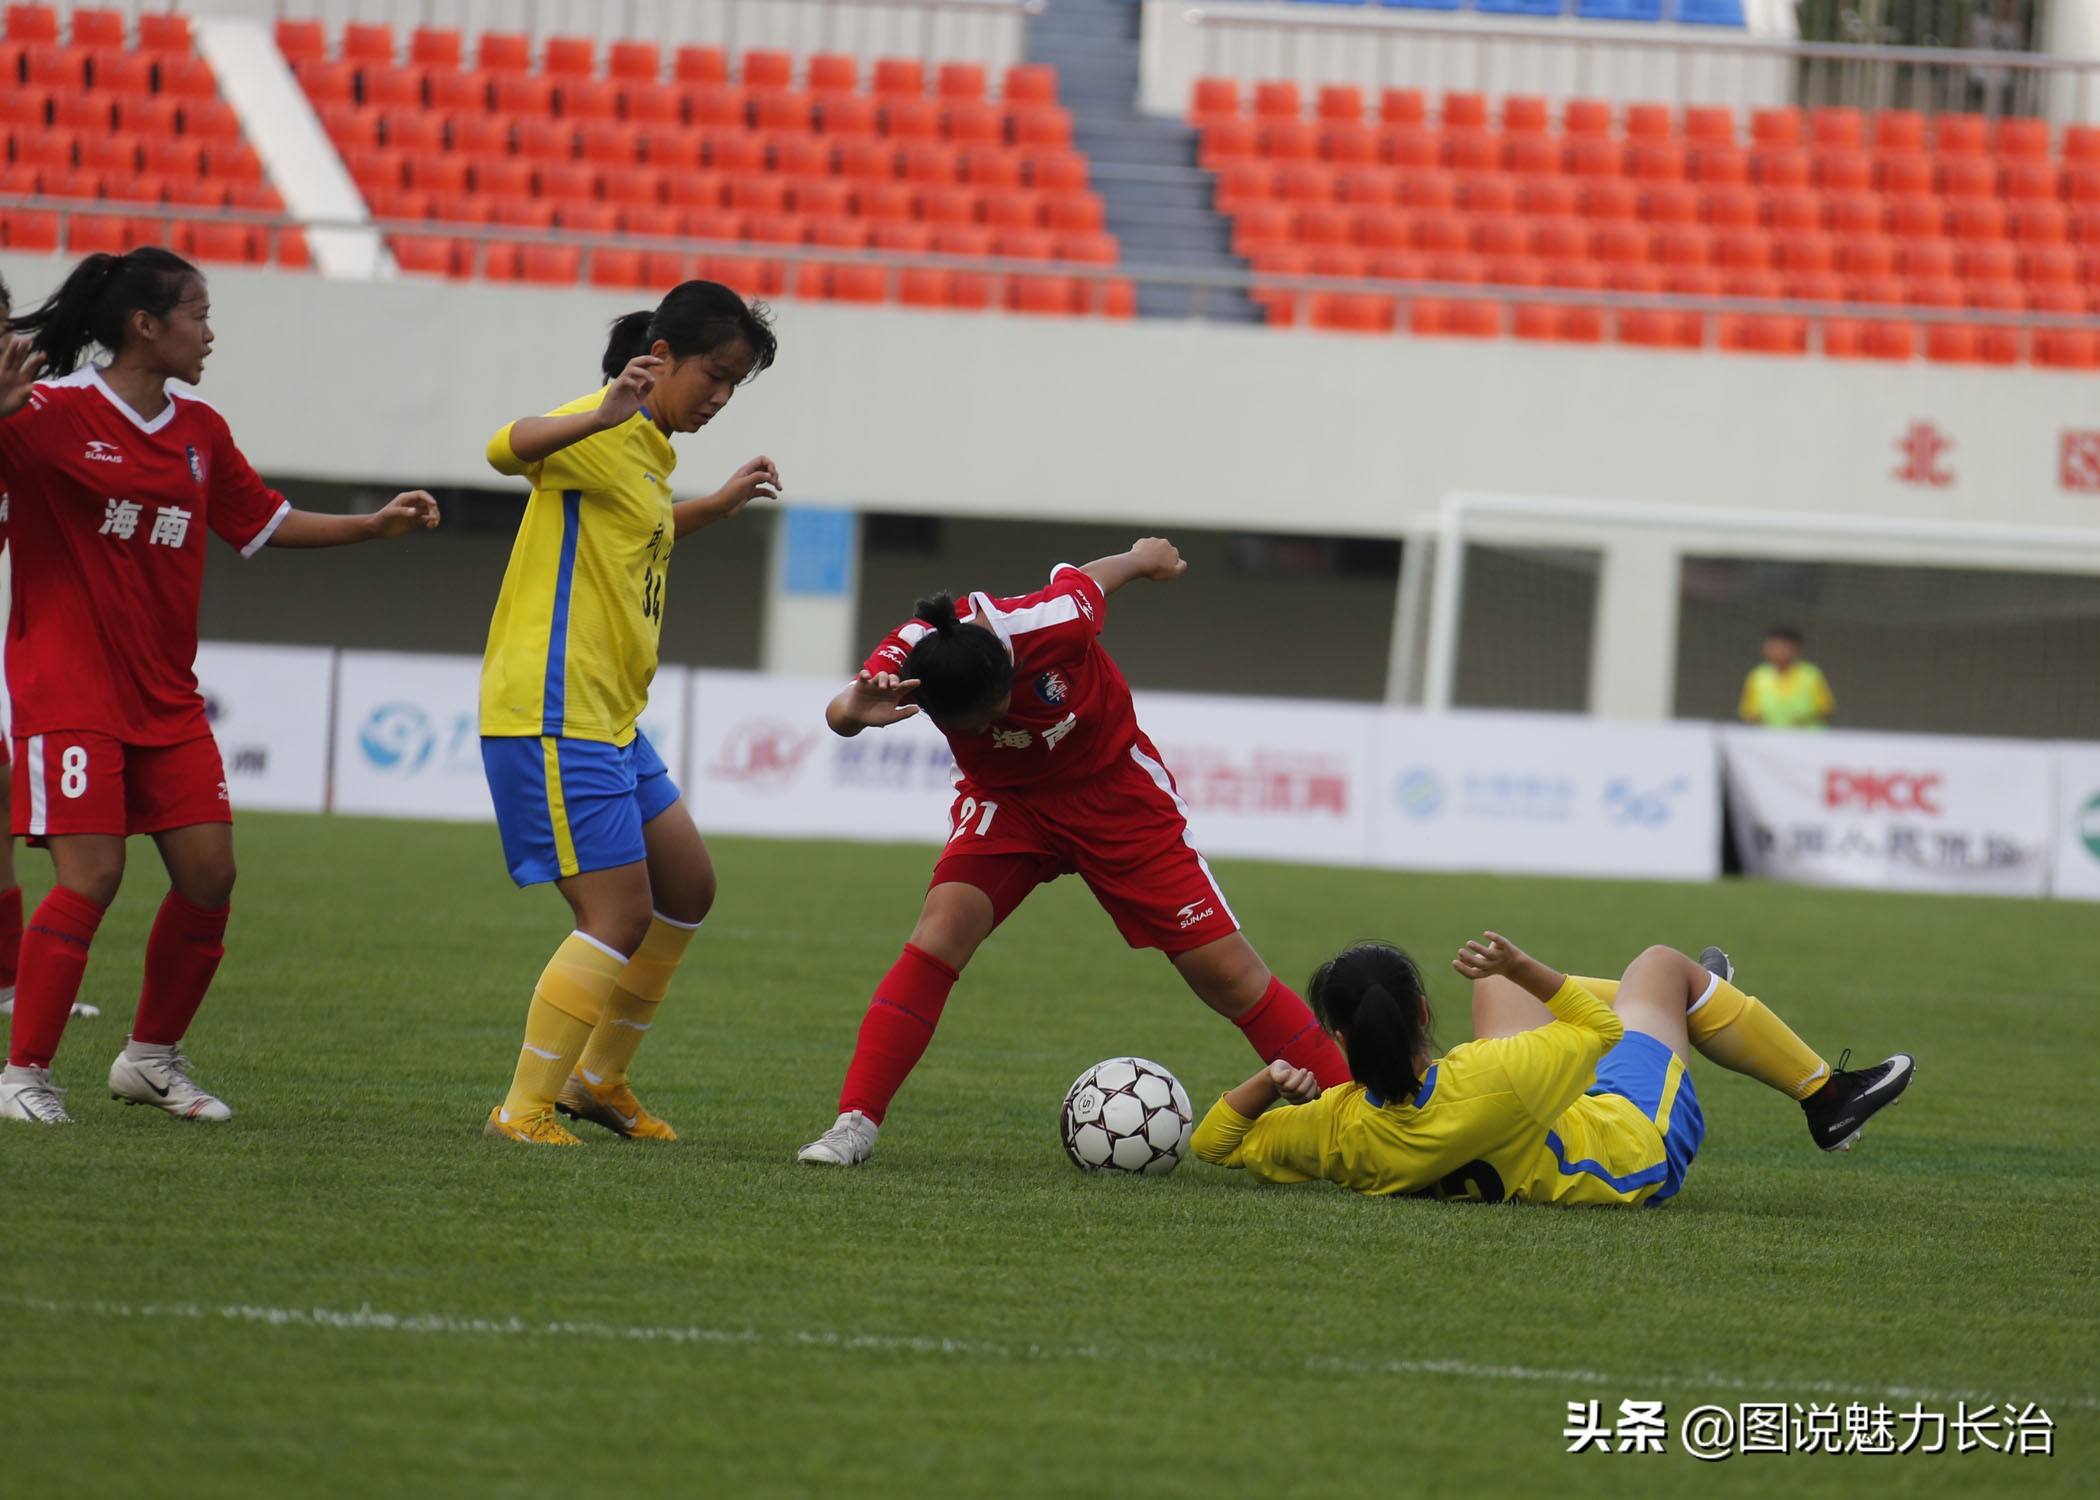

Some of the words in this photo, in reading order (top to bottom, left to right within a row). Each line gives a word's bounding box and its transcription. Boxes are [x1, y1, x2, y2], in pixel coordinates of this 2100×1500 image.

[84, 450, 123, 464] SUNAIS
[98, 497, 193, 549] 海南
[643, 566, 661, 626] 34
[60, 745, 88, 799] 8
[948, 796, 998, 844] 21
[1180, 907, 1214, 929] SUNAIS
